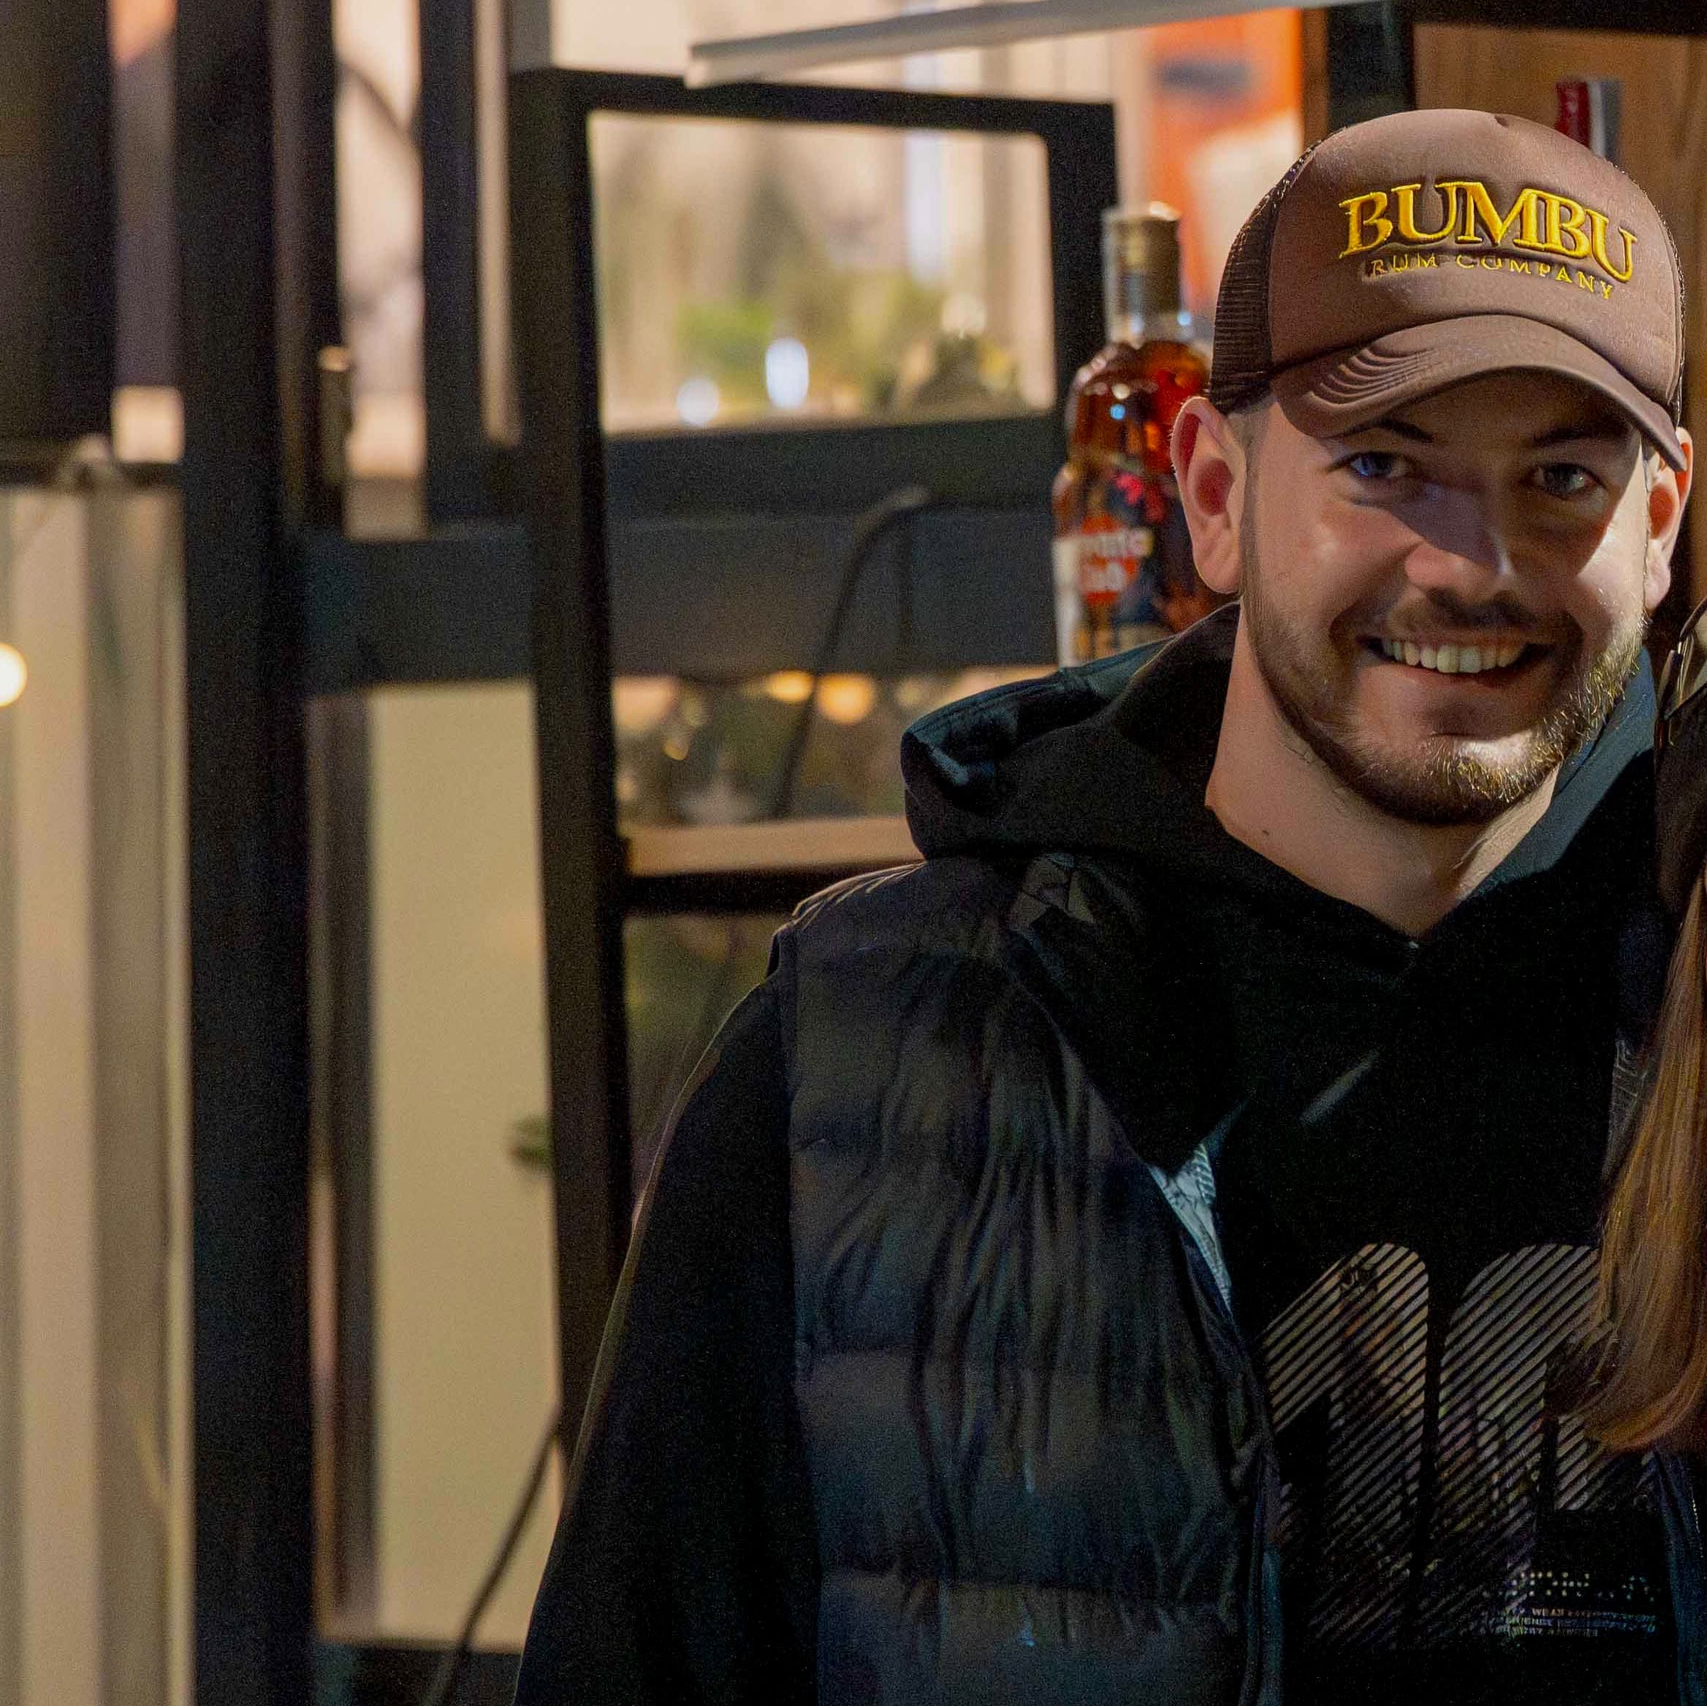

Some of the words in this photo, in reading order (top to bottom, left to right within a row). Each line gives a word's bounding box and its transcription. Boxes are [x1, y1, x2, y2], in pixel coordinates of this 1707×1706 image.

[1339, 180, 1637, 283] BUMBU
[1369, 253, 1439, 278] RUM
[1457, 252, 1614, 301] COMPANY
